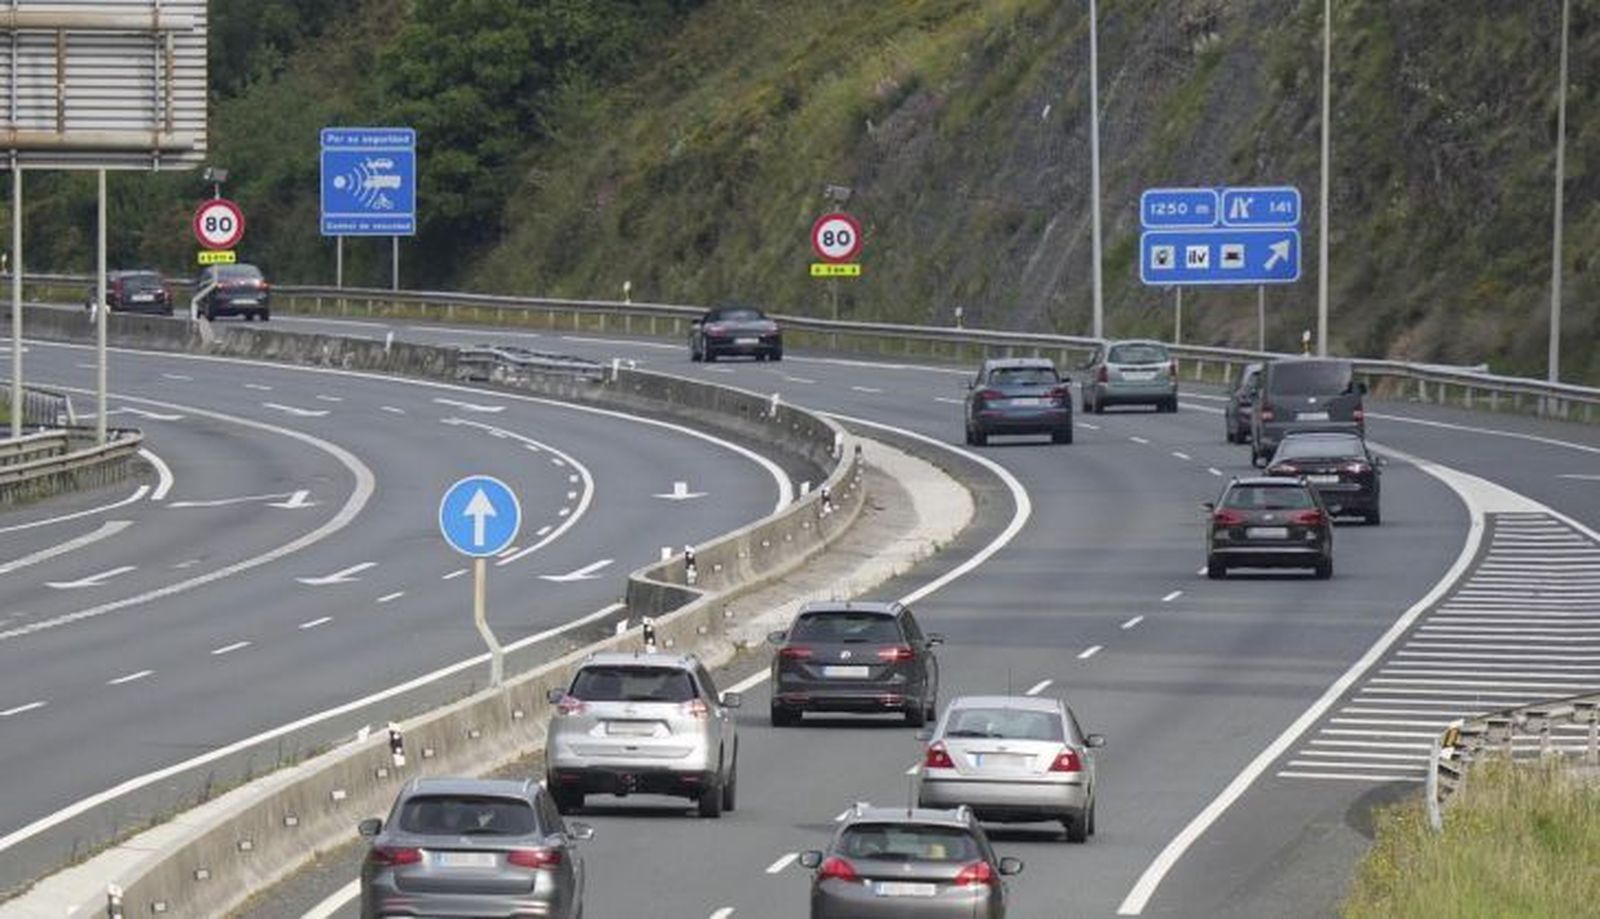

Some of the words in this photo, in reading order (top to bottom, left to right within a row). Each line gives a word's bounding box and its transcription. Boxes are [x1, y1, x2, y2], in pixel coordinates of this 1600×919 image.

[326, 134, 344, 143] Por
[1150, 202, 1188, 215] 1250
[1269, 201, 1292, 213] 141
[206, 216, 232, 232] 80
[823, 230, 850, 247] 80
